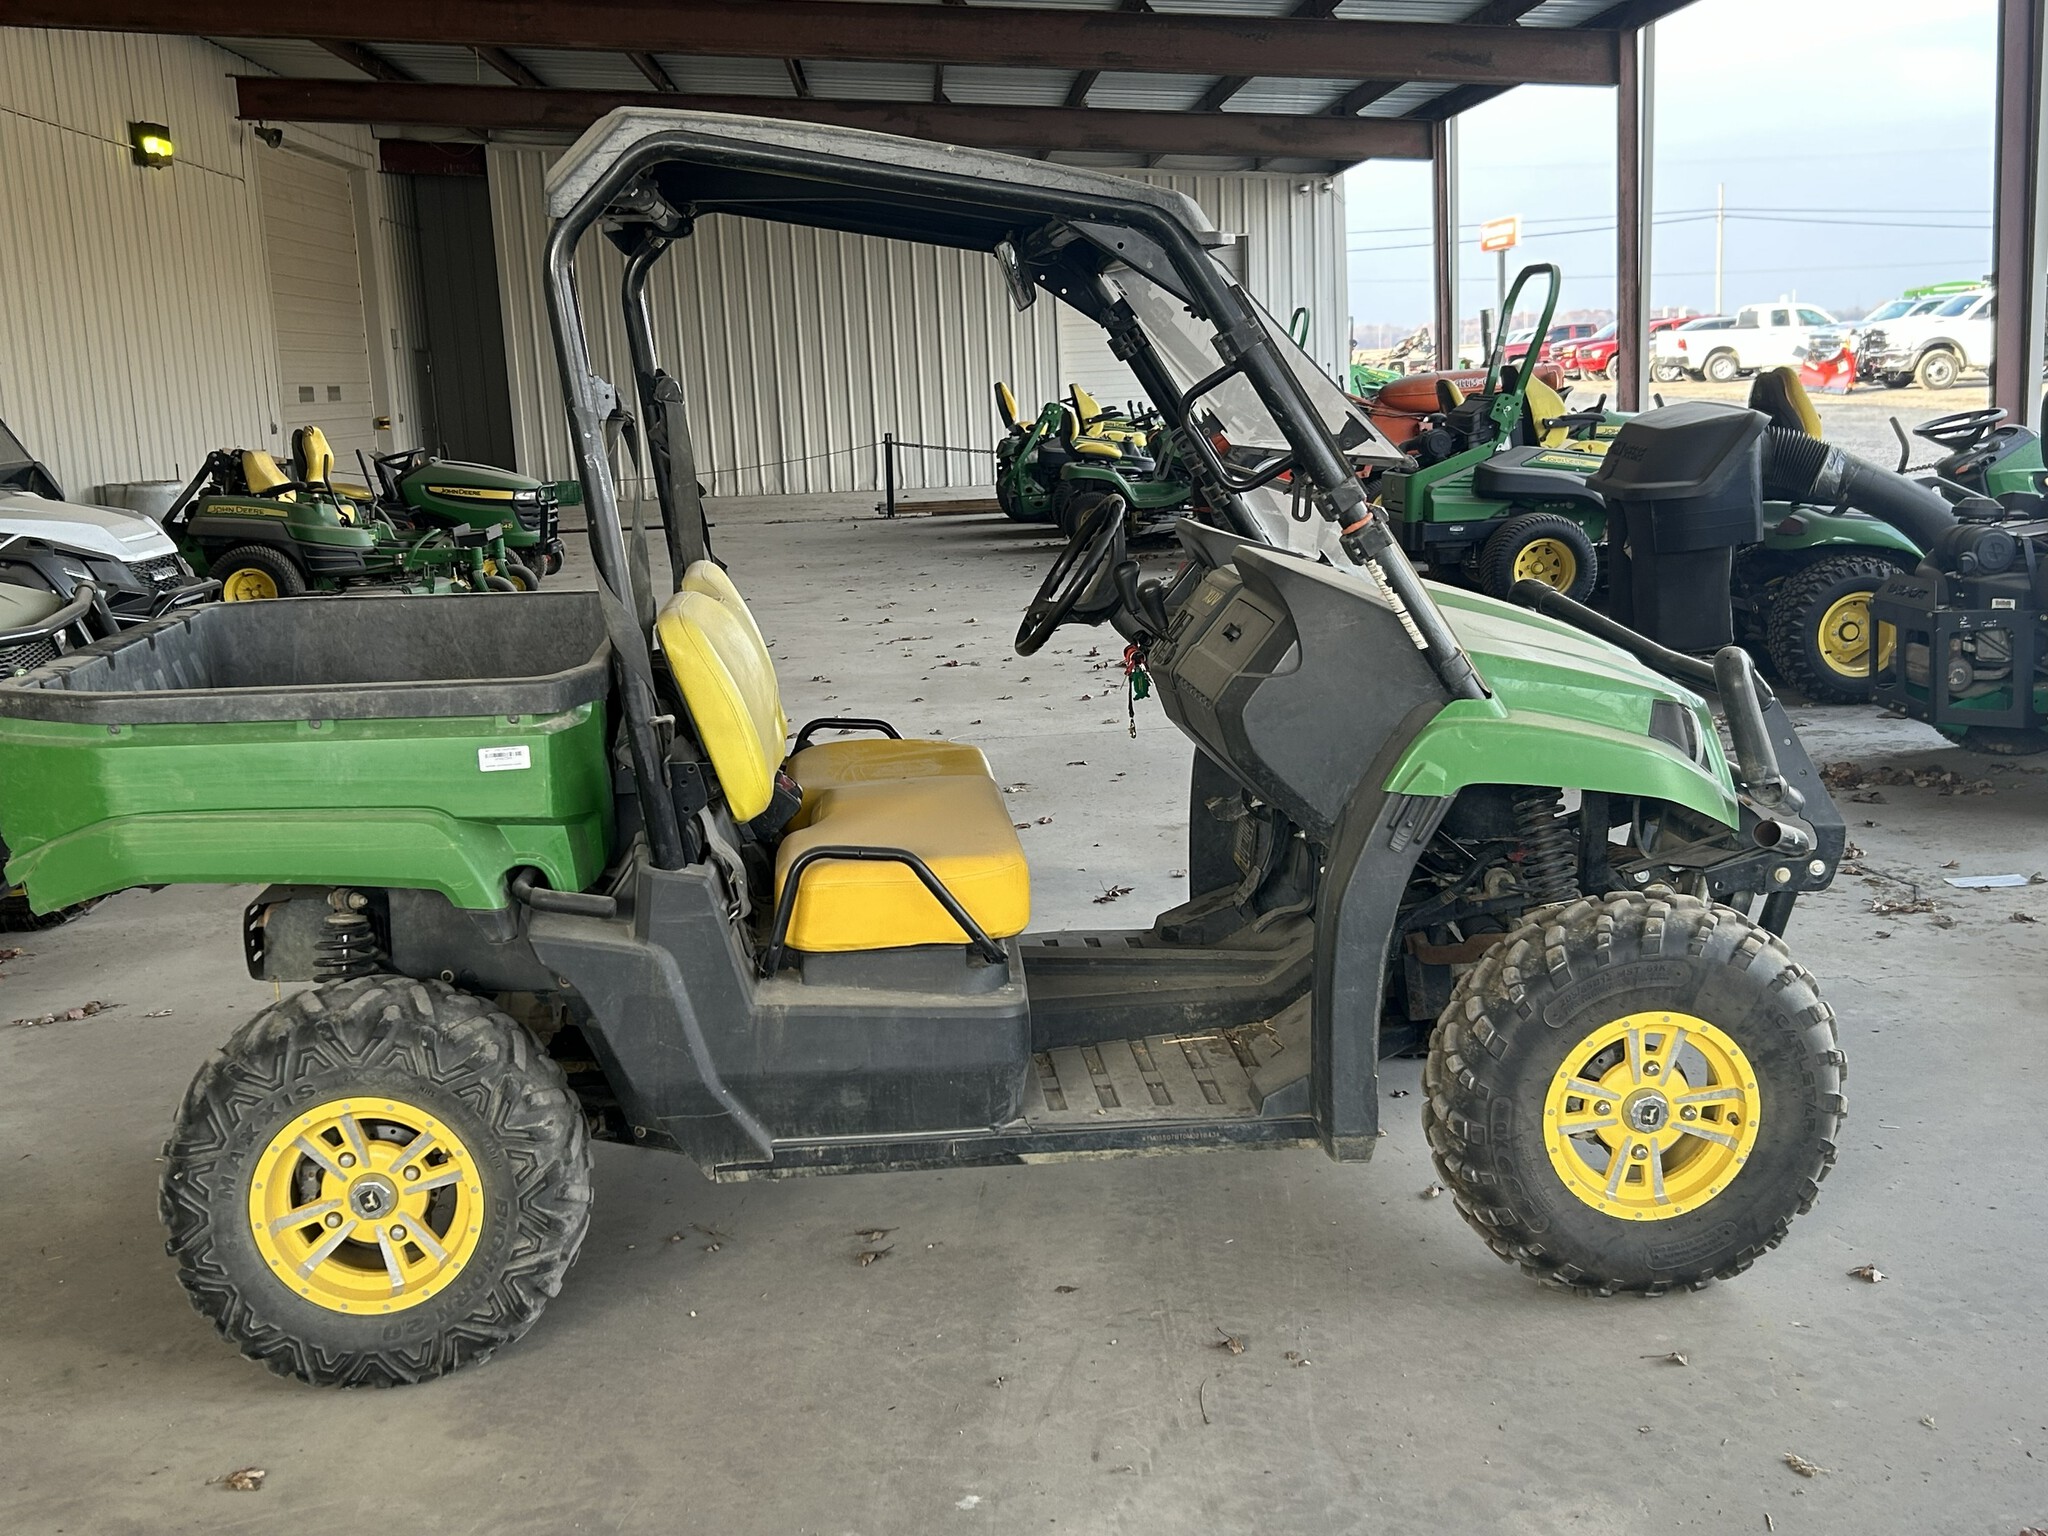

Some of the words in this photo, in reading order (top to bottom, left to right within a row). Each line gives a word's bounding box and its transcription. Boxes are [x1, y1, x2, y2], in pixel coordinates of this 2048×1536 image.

[211, 505, 234, 514] JOHN
[236, 506, 265, 516] DEERE
[440, 487, 458, 495] JOHN
[458, 488, 481, 496] DEERE
[1202, 589, 1224, 606] XUV
[1775, 1013, 1817, 1133] CARLSTAR
[218, 1084, 317, 1201] MAXXIS
[437, 1196, 511, 1323] BIGHORN
